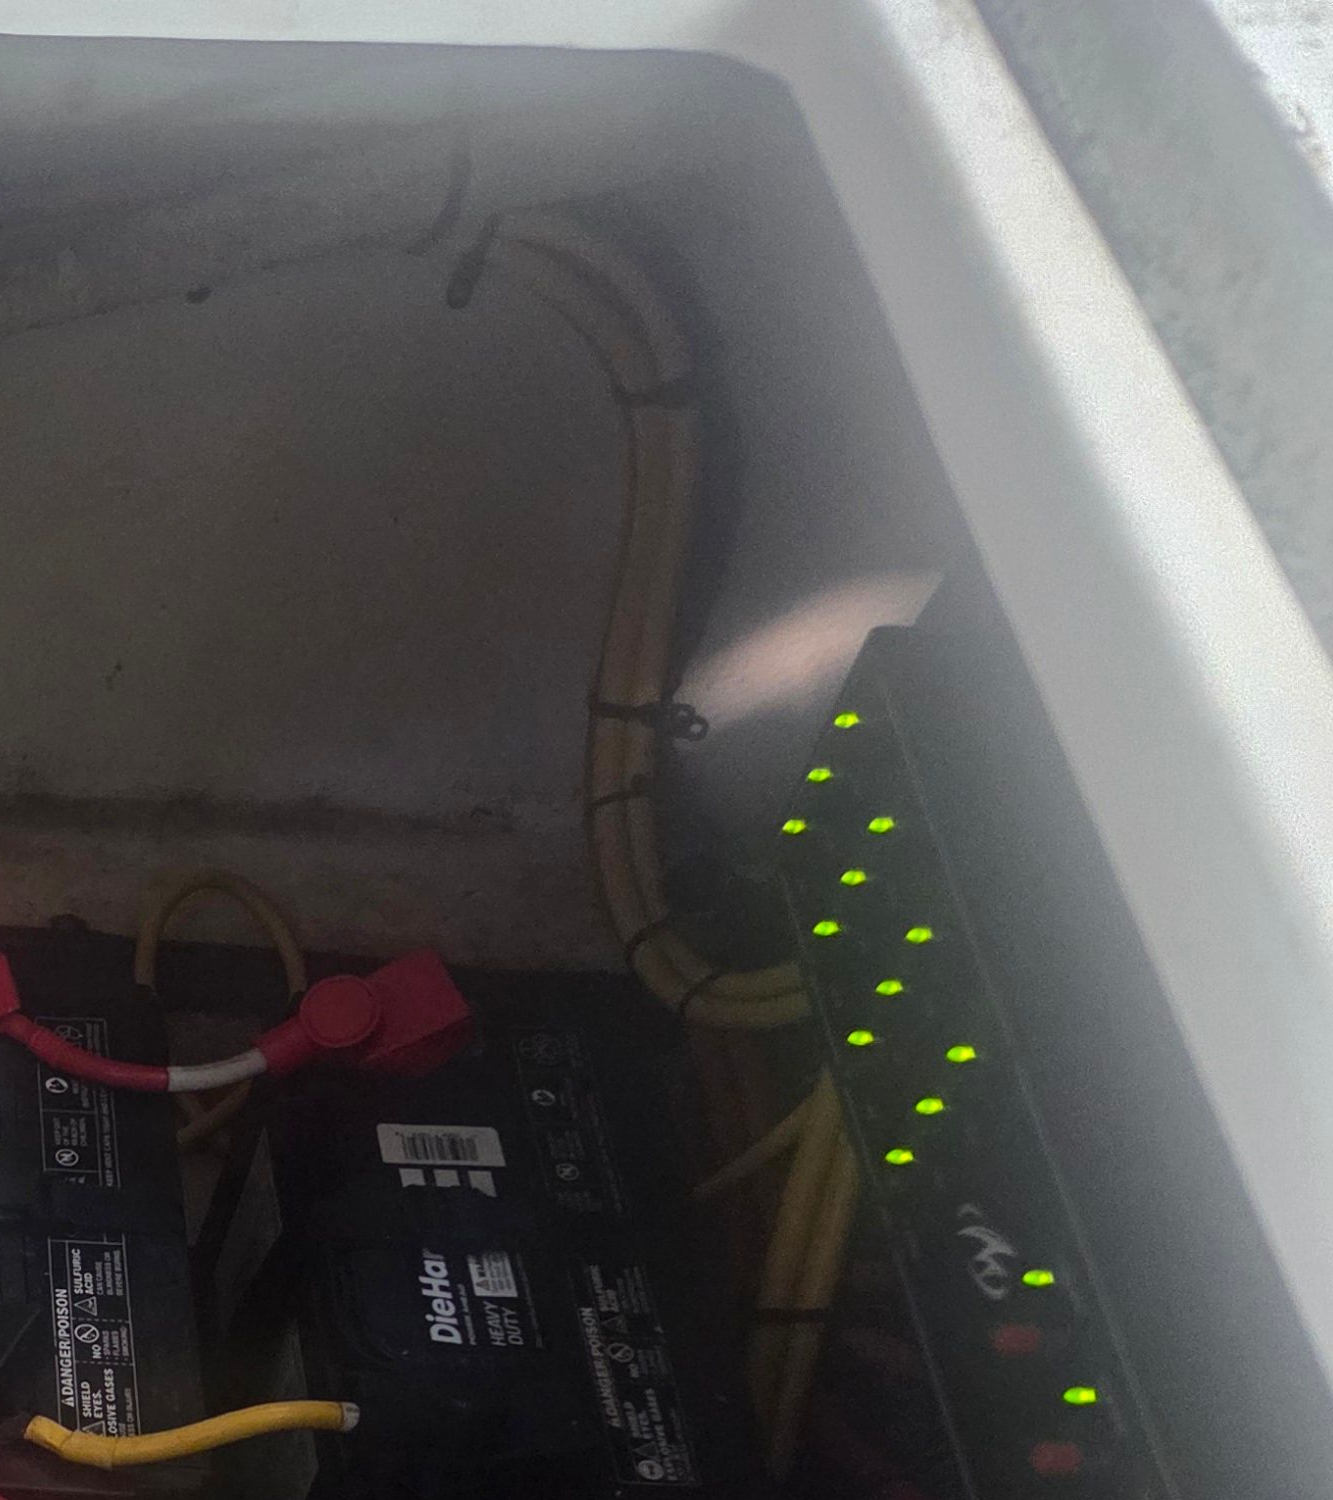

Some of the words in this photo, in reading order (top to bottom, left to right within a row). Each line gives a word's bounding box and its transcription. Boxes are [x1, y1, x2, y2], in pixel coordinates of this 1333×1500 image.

[70, 1247, 83, 1294] SULFURIC
[83, 1271, 94, 1295] ACID
[54, 1287, 74, 1395] DANGER/POISON
[481, 1299, 507, 1346] HEAVY
[500, 1305, 524, 1345] DUTY
[91, 1343, 102, 1359] NO
[80, 1380, 92, 1418] SHIELD
[103, 1367, 116, 1402] GASES
